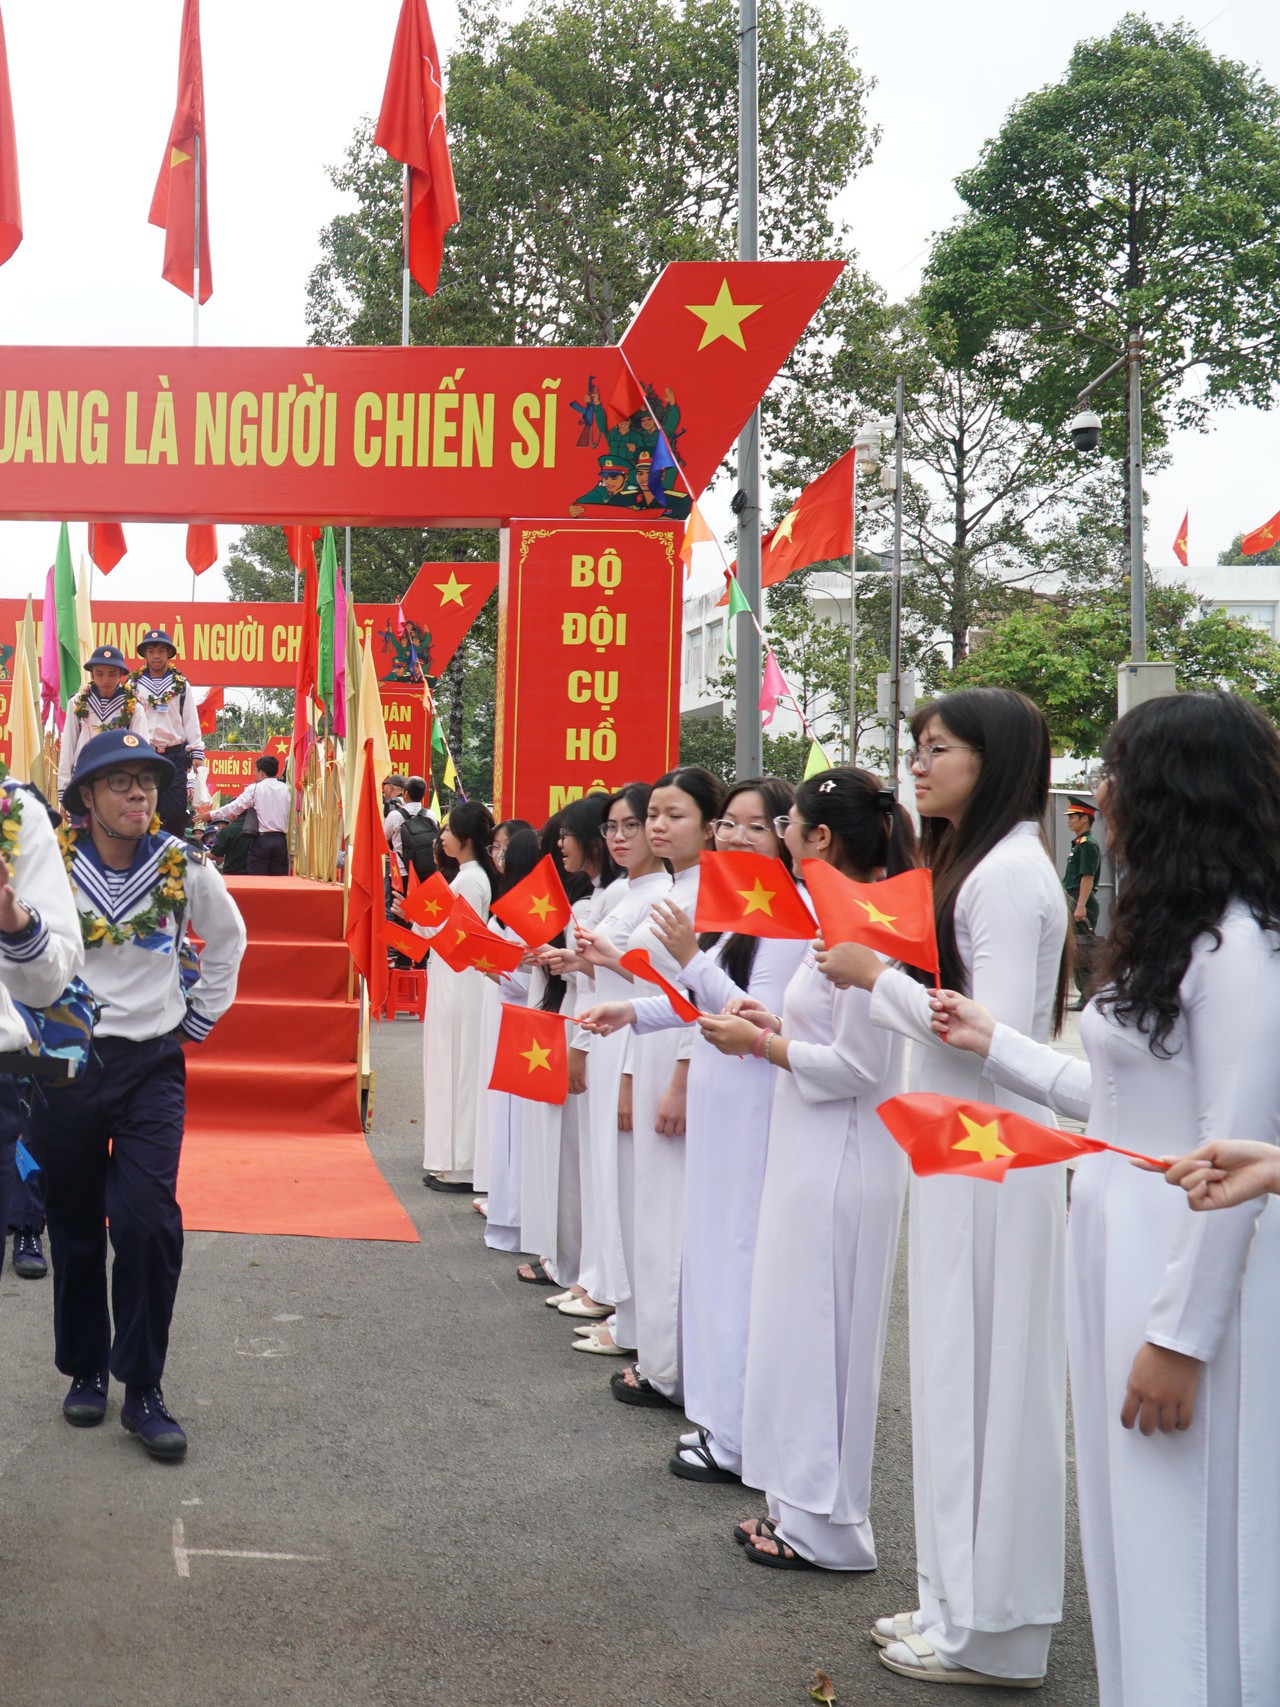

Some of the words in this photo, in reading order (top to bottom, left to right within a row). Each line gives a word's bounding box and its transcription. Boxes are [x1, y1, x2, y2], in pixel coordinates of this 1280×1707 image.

[124, 375, 179, 465] LÀ
[194, 373, 338, 468] NGƯỜI
[353, 368, 495, 468] CHIẾN
[510, 377, 562, 469] SĨ
[570, 547, 623, 595] BỘ
[193, 615, 266, 662] NGƯỜI
[561, 605, 627, 653] ĐỘI
[381, 702, 412, 722] UÂN
[567, 669, 619, 711] CỤ
[565, 717, 617, 762] HỒ
[212, 755, 240, 775] CHIẾN
[242, 757, 252, 776] SĨ
